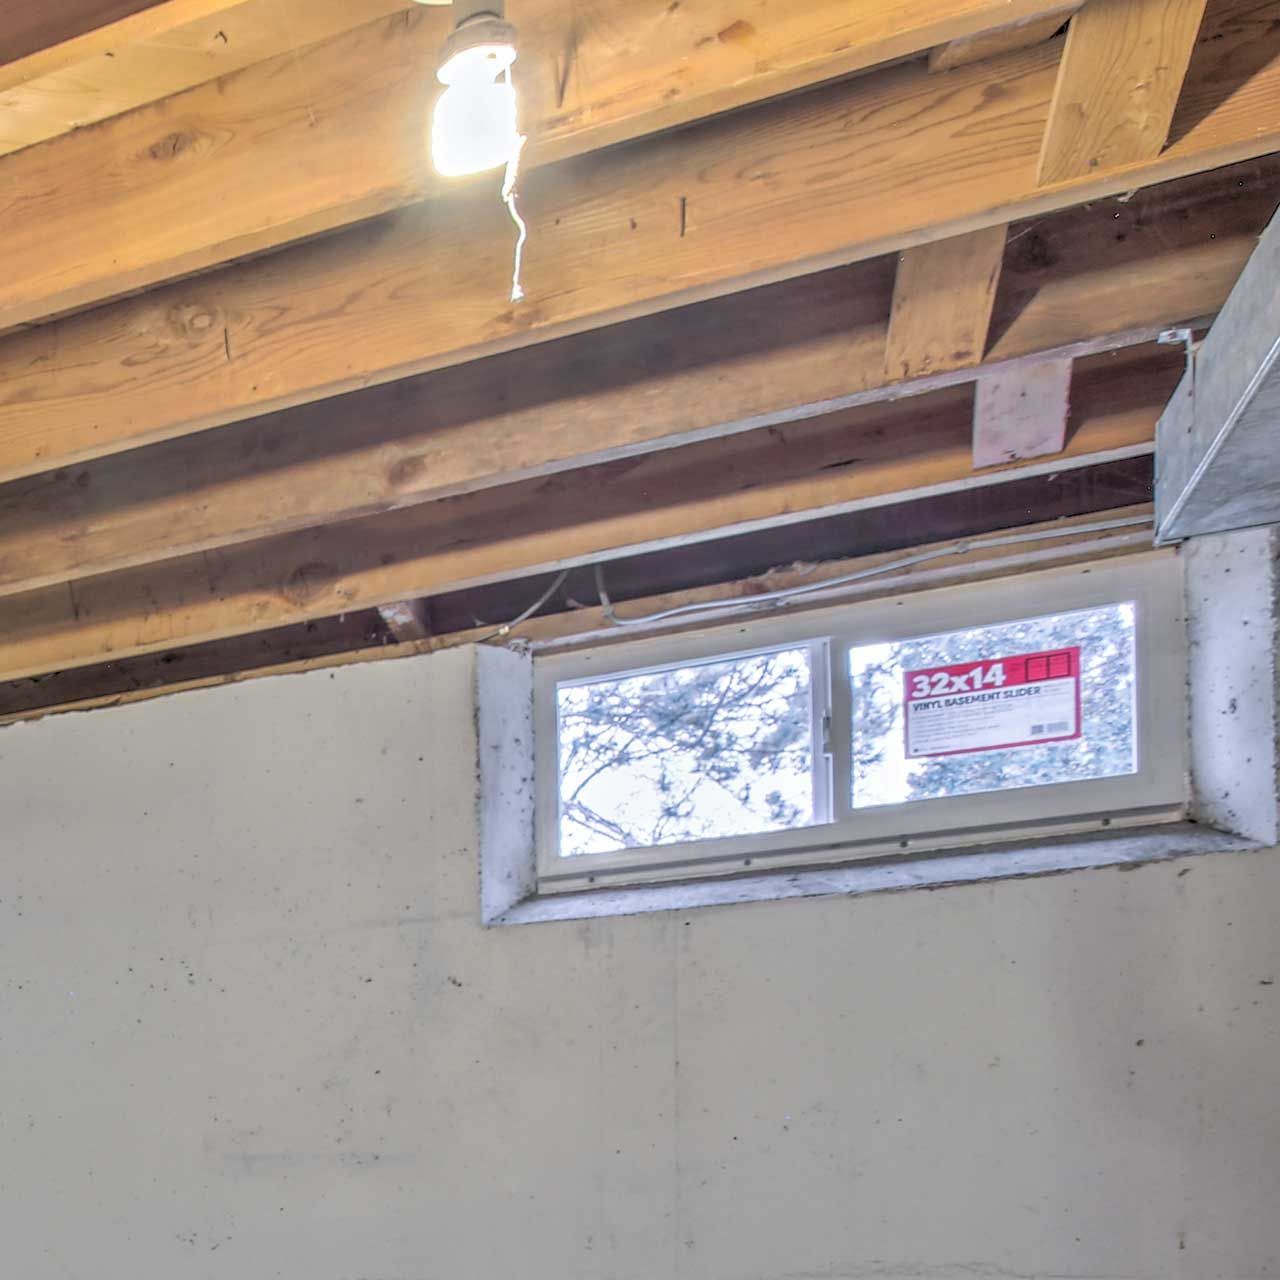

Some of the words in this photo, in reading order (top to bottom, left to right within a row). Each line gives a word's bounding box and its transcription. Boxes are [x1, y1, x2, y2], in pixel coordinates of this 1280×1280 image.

[912, 663, 1006, 698] 32x14
[912, 700, 944, 712] VINYL
[944, 692, 1000, 707] BASEMENT
[1003, 686, 1041, 699] SLIDER
